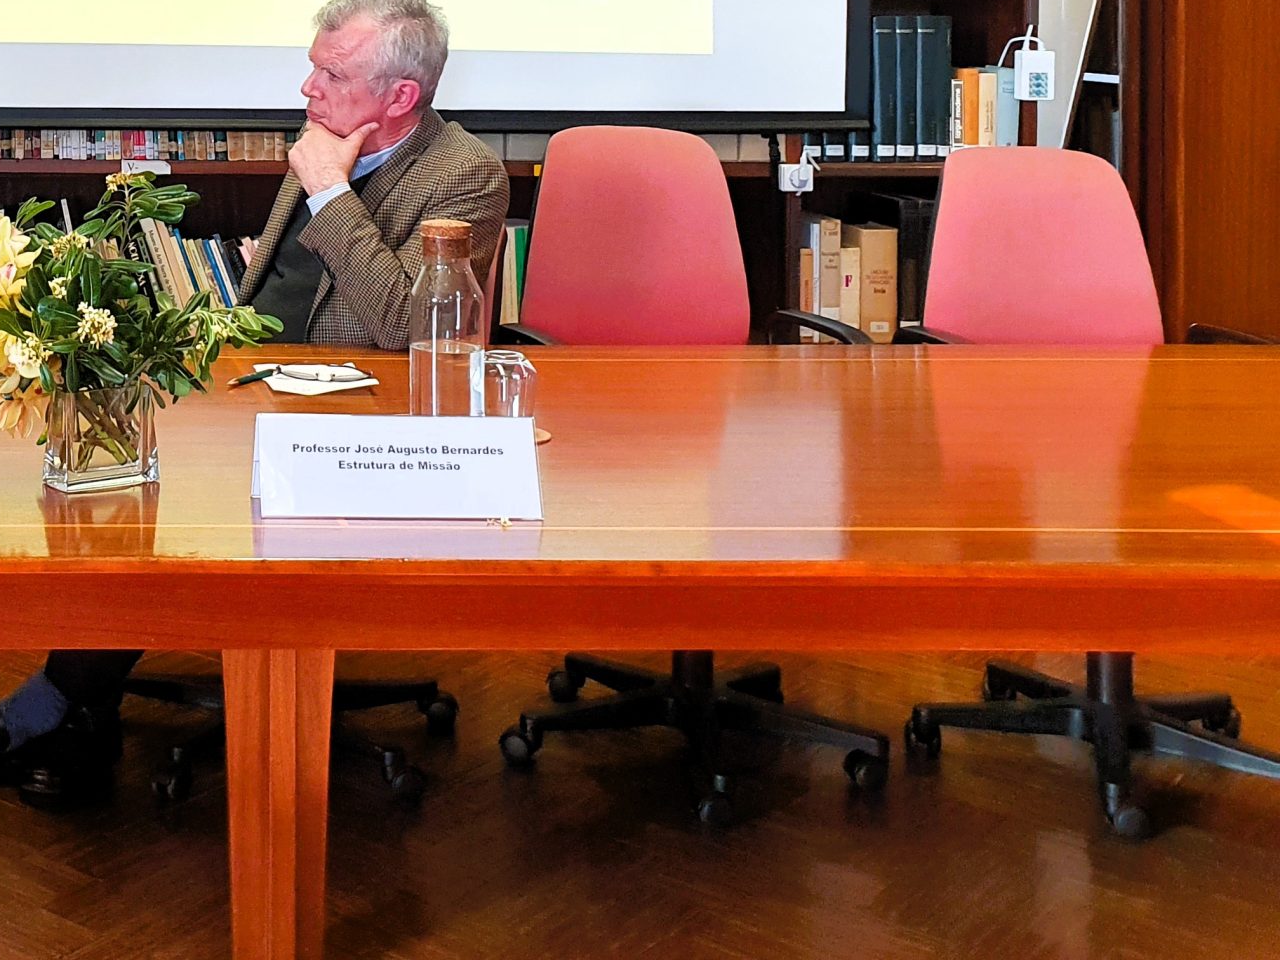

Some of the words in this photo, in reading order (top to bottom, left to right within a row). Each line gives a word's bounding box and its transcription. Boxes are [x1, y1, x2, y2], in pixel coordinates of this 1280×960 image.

[292, 443, 351, 454] Professor
[354, 443, 384, 454] José
[387, 444, 438, 457] Augusto
[441, 445, 504, 456] Bernardes
[338, 460, 396, 470] Estrutura
[399, 460, 414, 470] de
[417, 460, 461, 471] Missão
